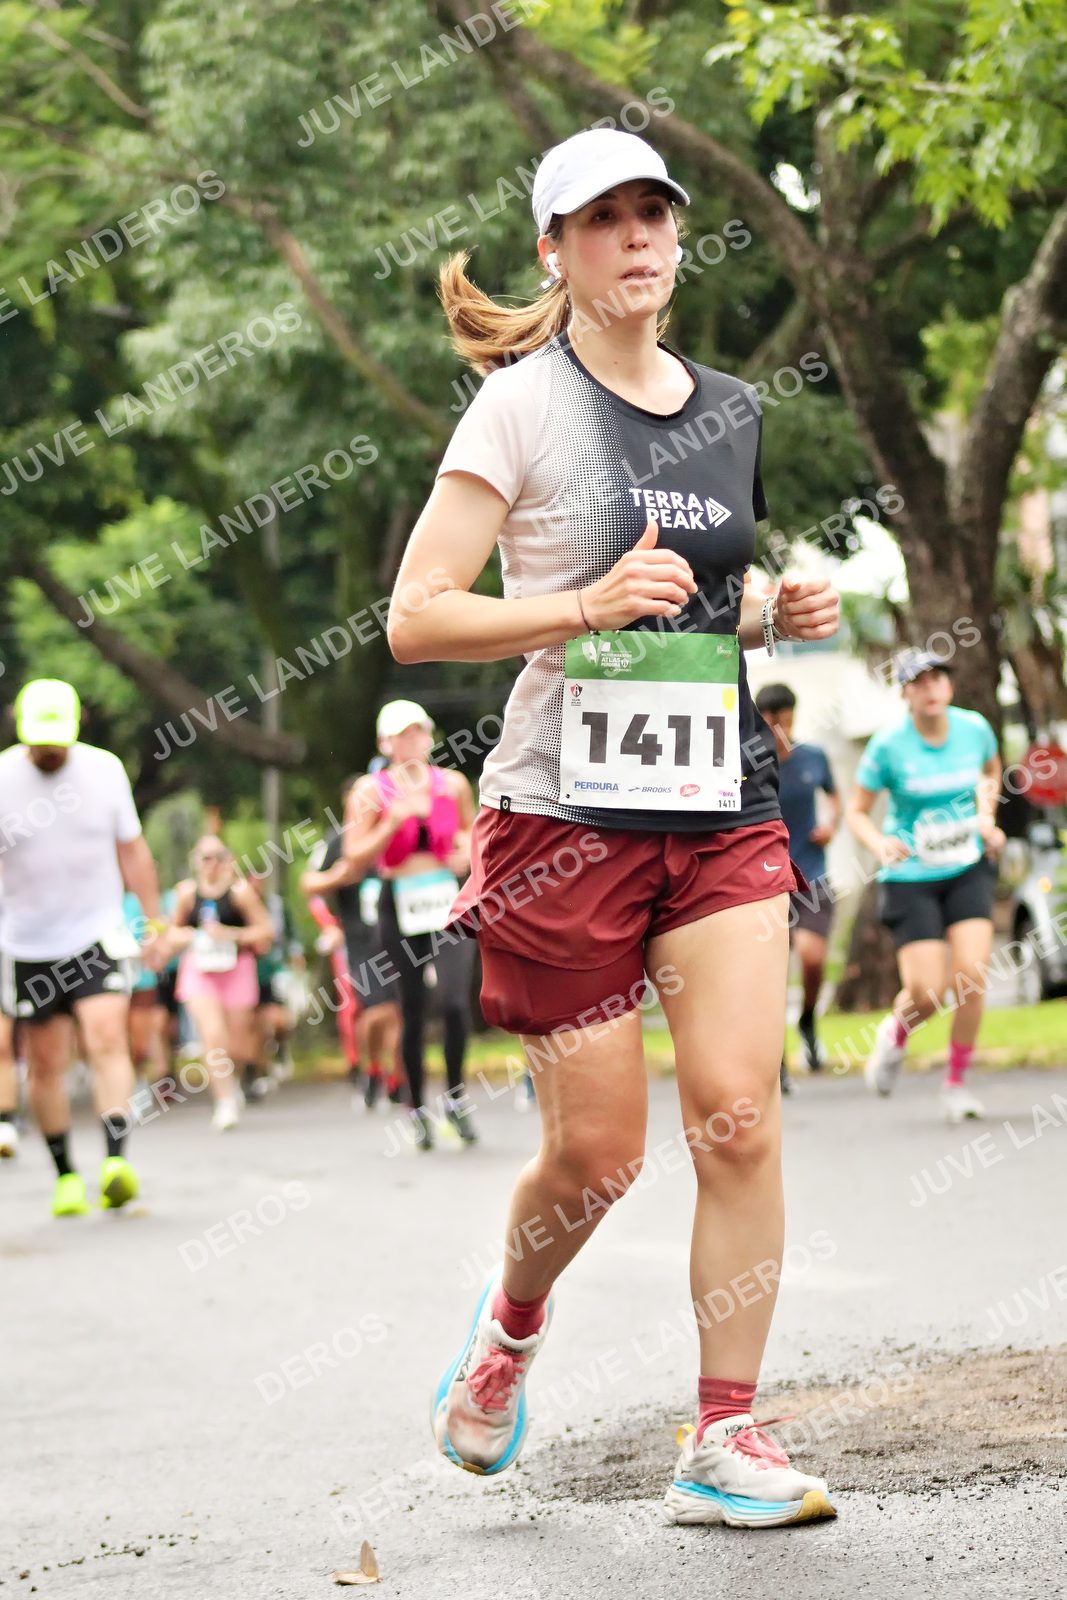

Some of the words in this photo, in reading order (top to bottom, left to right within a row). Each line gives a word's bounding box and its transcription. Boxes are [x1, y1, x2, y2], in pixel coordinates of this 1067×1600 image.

[629, 488, 704, 511] TERRA
[646, 508, 707, 530] PEAK
[582, 712, 725, 767] 1411
[574, 781, 619, 791] PERDURA
[719, 800, 735, 808] 1411
[725, 1424, 747, 1436] HOK
